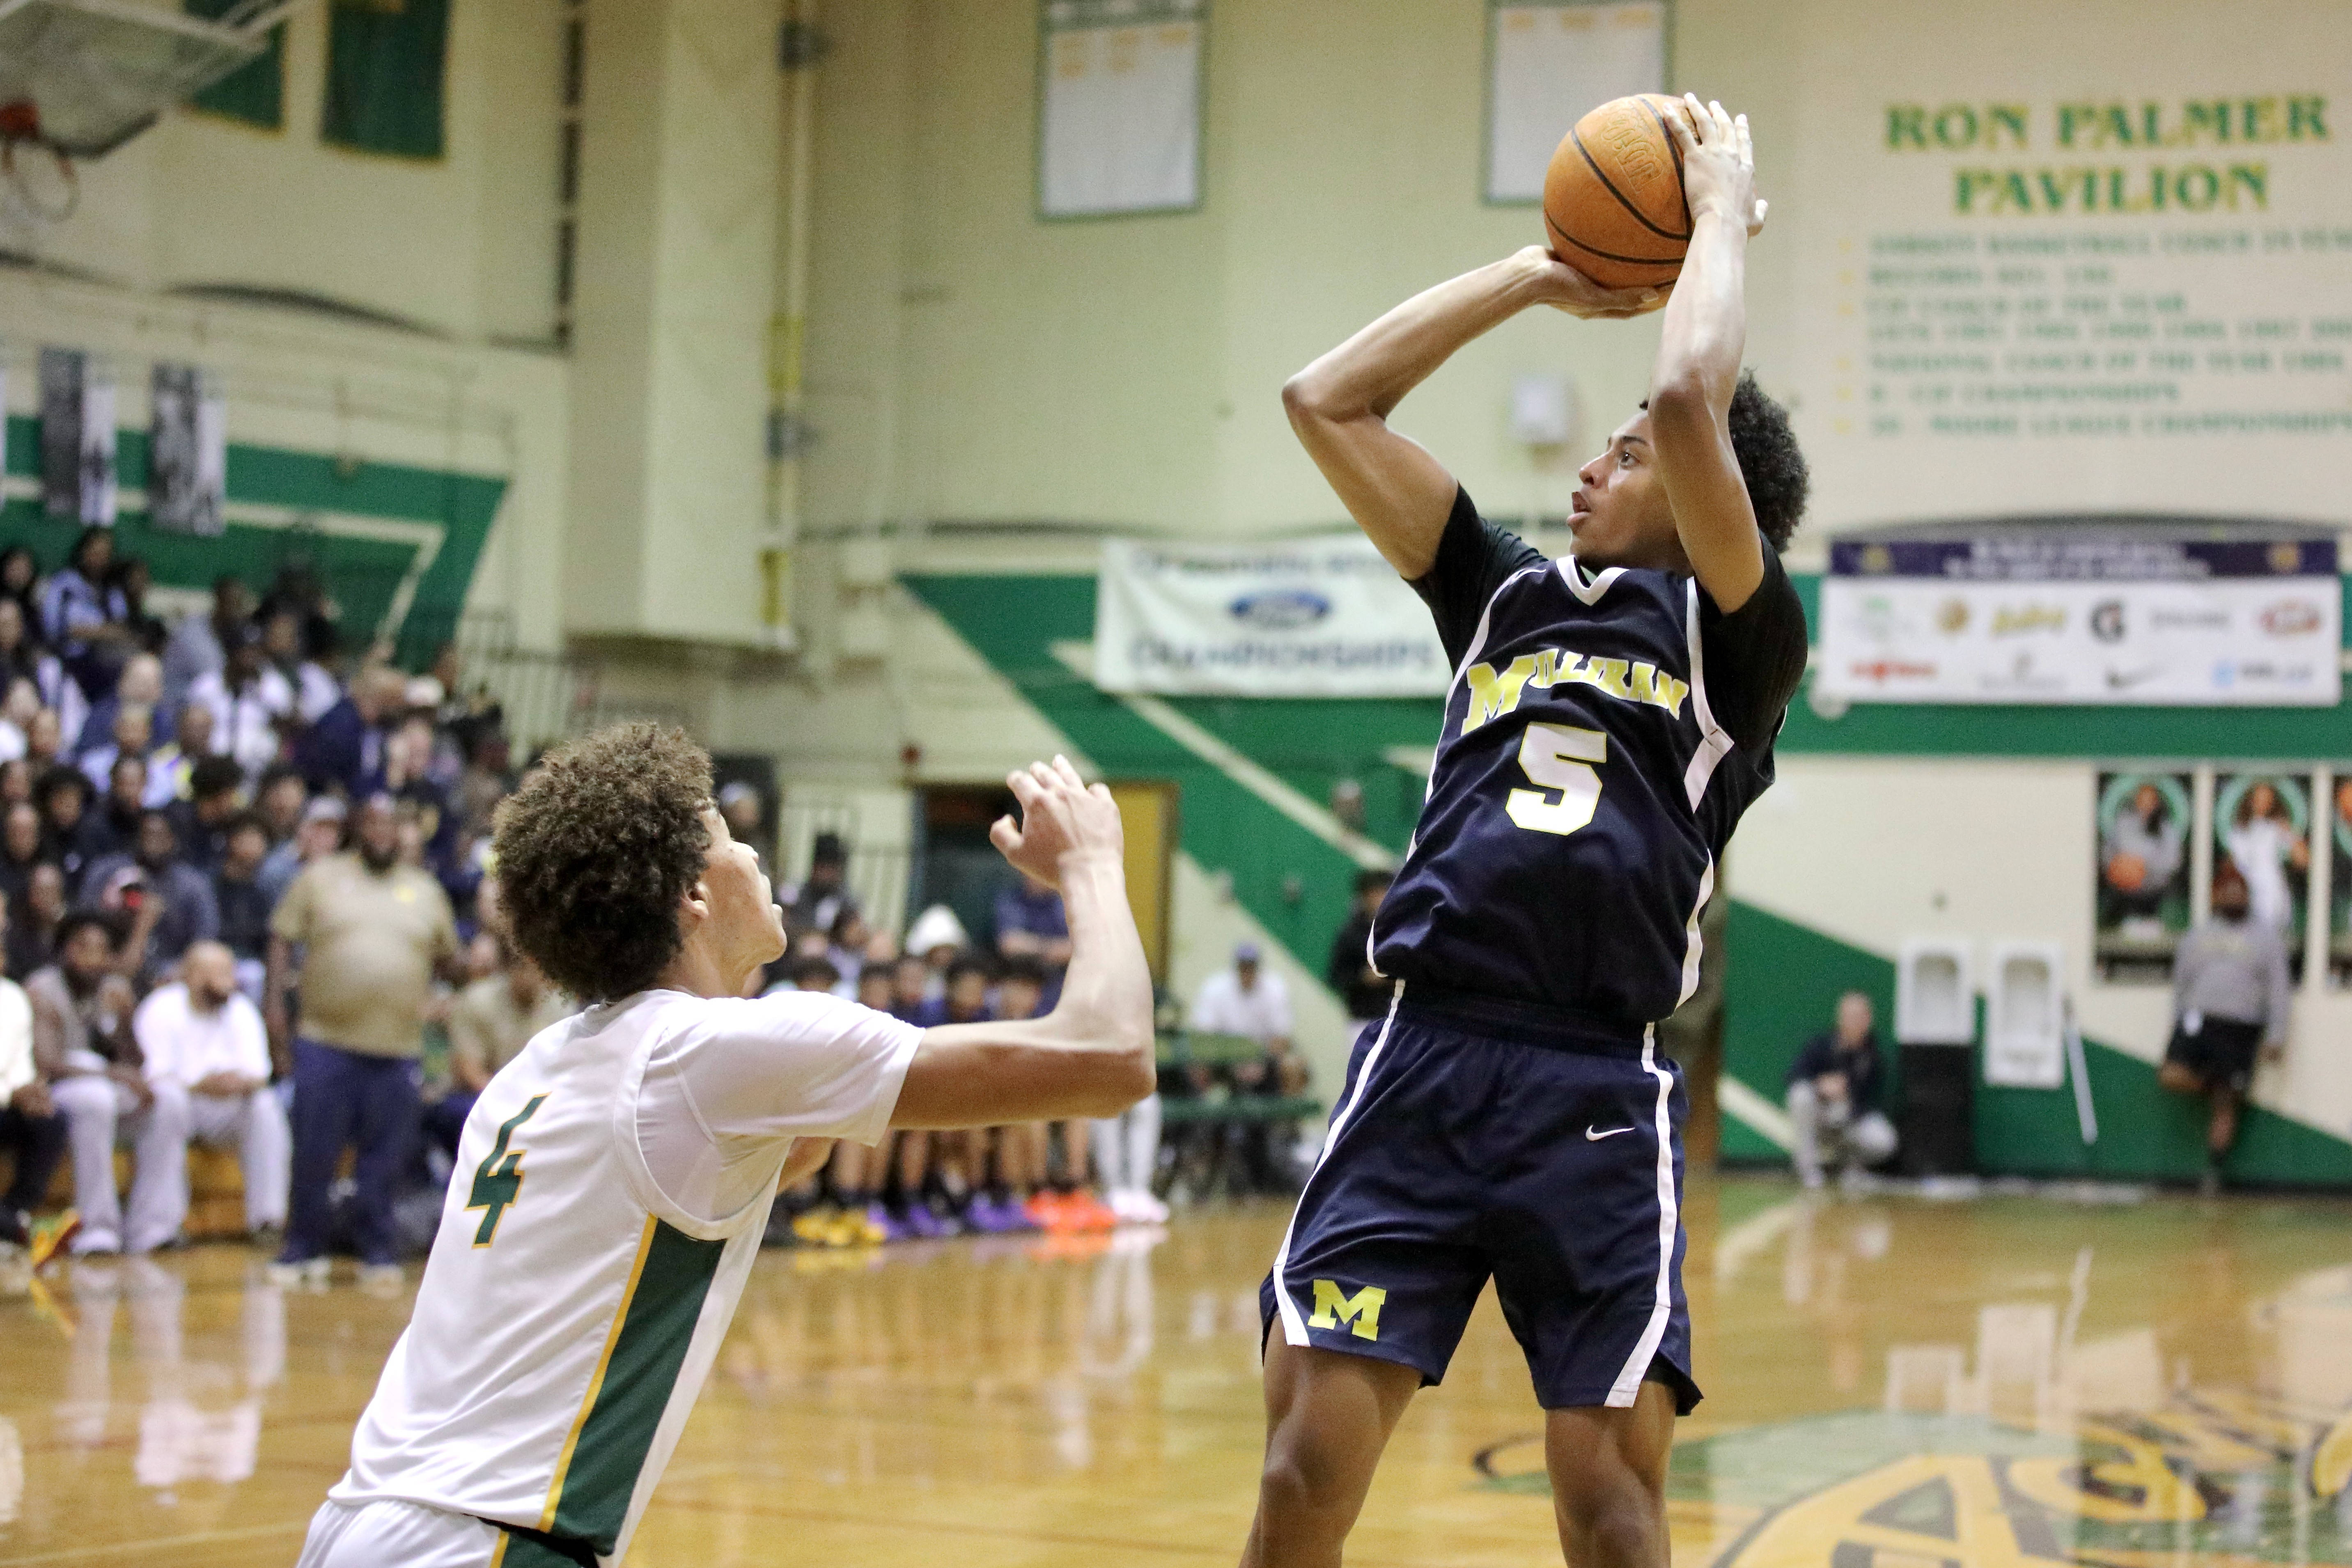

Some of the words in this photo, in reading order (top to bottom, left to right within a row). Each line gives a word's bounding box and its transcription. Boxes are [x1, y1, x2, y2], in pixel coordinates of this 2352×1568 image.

[1886, 103, 2030, 150] RON
[2057, 94, 2333, 149] PALMER
[1953, 161, 2269, 214] PAVILION
[1505, 721, 1607, 836] 5
[463, 1091, 553, 1250] 4
[1307, 1279, 1387, 1342] M
